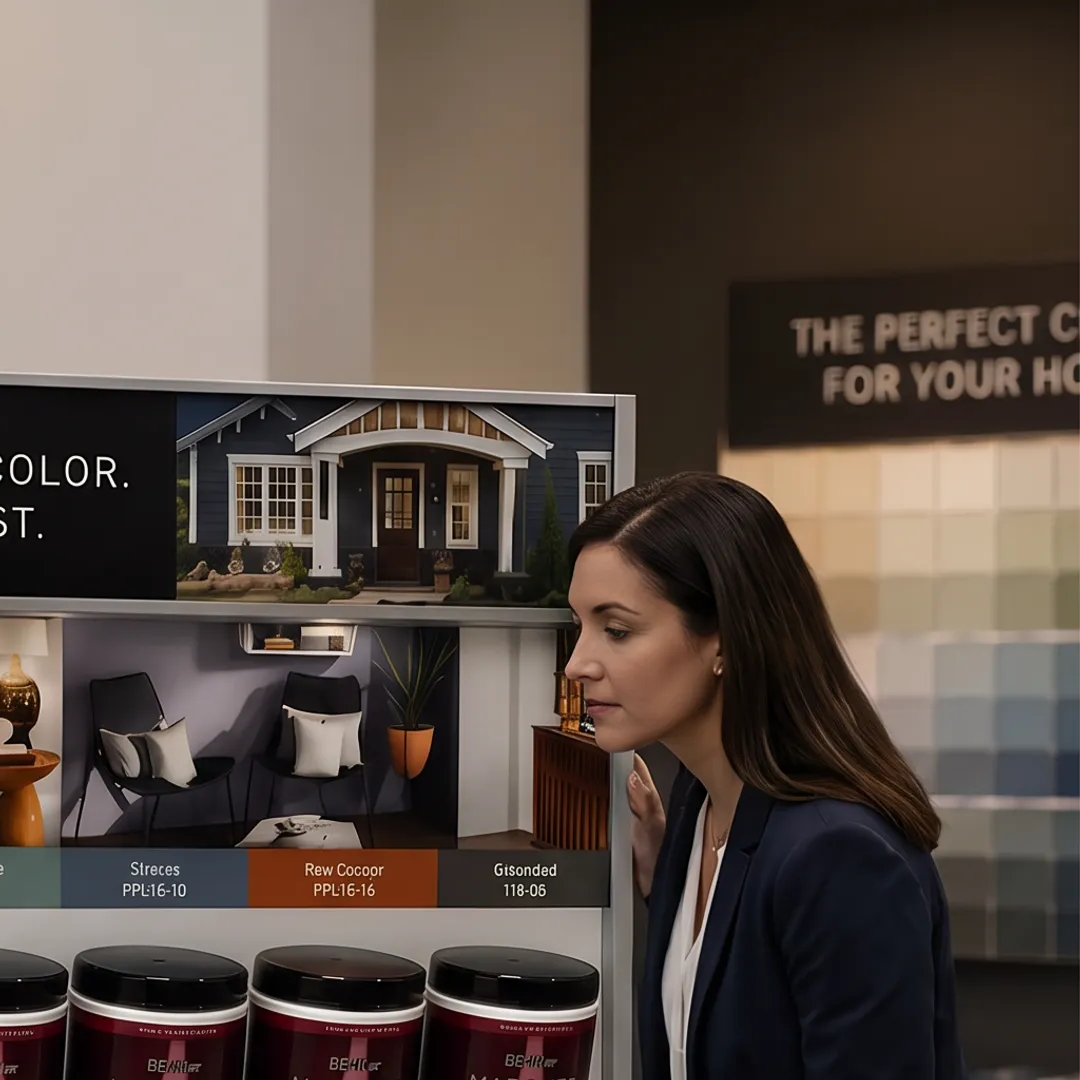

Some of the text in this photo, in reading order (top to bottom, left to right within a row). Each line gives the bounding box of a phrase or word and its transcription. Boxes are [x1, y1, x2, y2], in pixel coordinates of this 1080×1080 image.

[789, 313, 864, 358] THE
[874, 304, 1041, 355] PERFECT
[822, 362, 901, 405] FOR
[910, 356, 1021, 401] YOUR
[304, 862, 334, 877] Rew
[503, 883, 547, 897] 118-06
